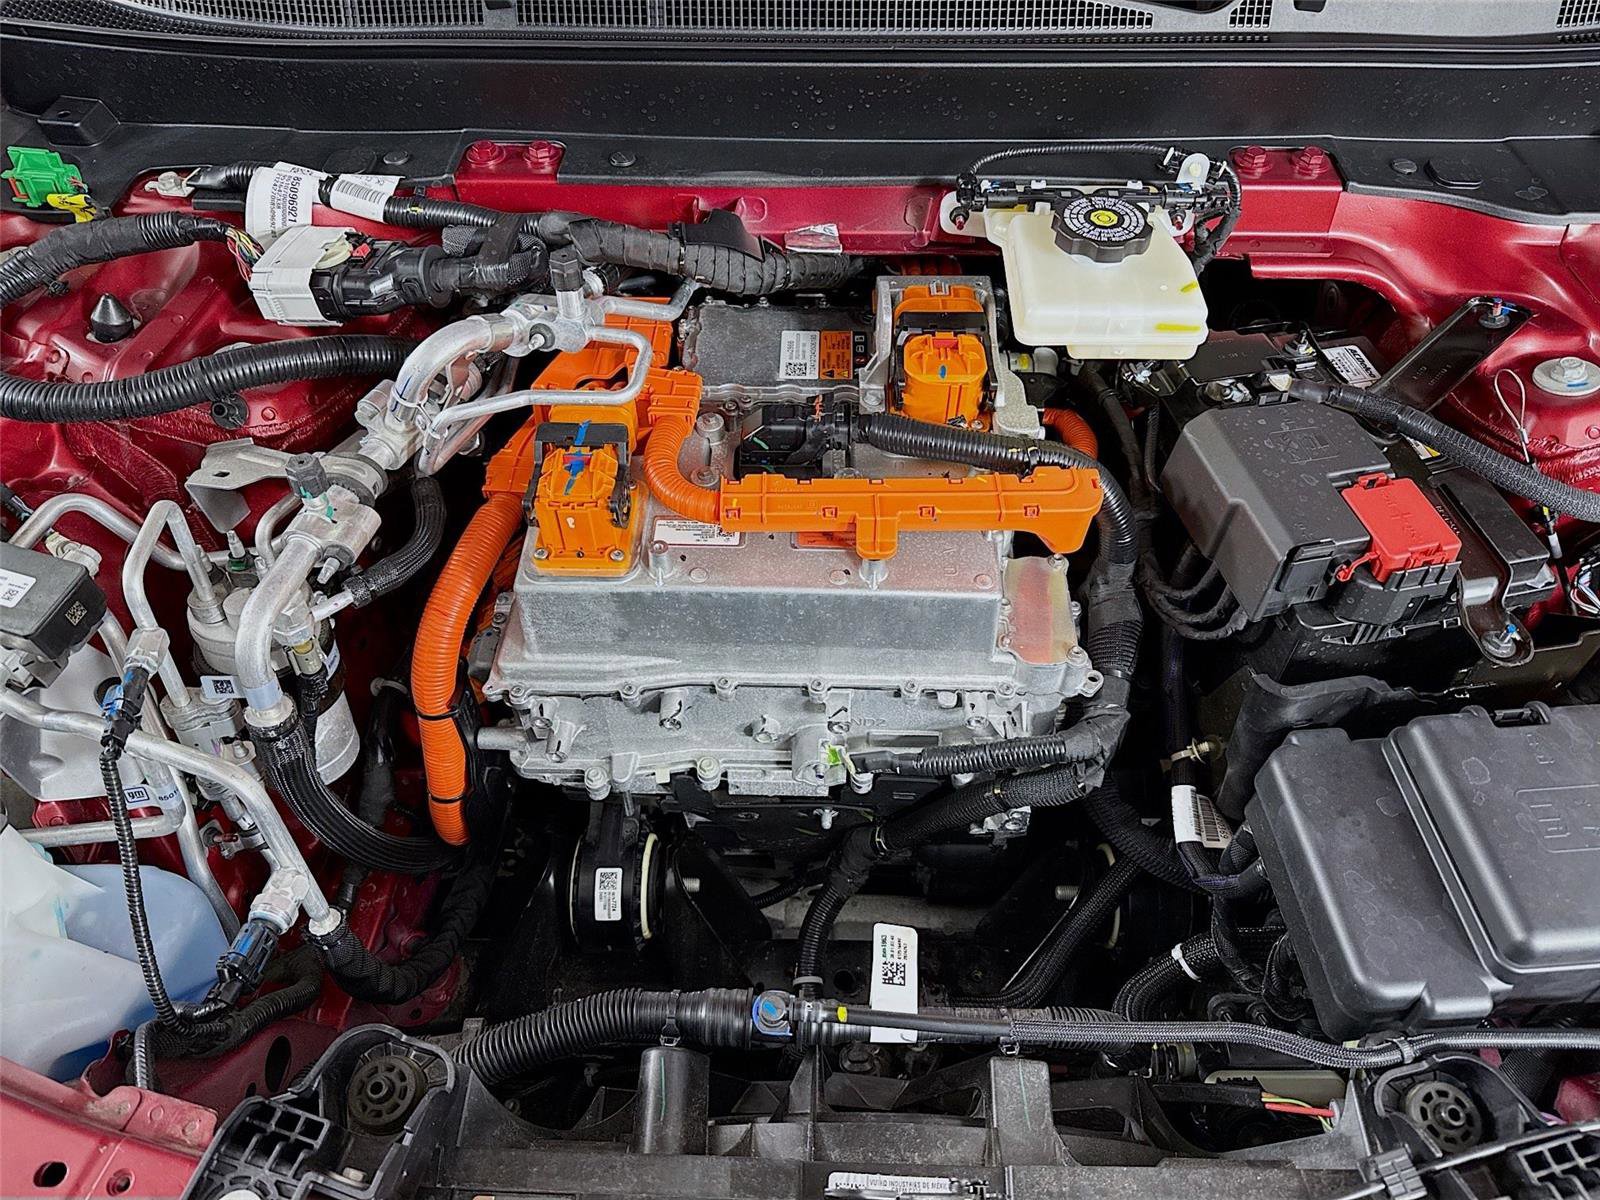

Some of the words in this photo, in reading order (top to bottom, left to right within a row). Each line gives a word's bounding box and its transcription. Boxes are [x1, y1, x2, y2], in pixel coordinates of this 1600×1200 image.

[287, 175, 302, 223] 85096921
[1348, 348, 1376, 378] ACDelco
[127, 790, 145, 800] gm
